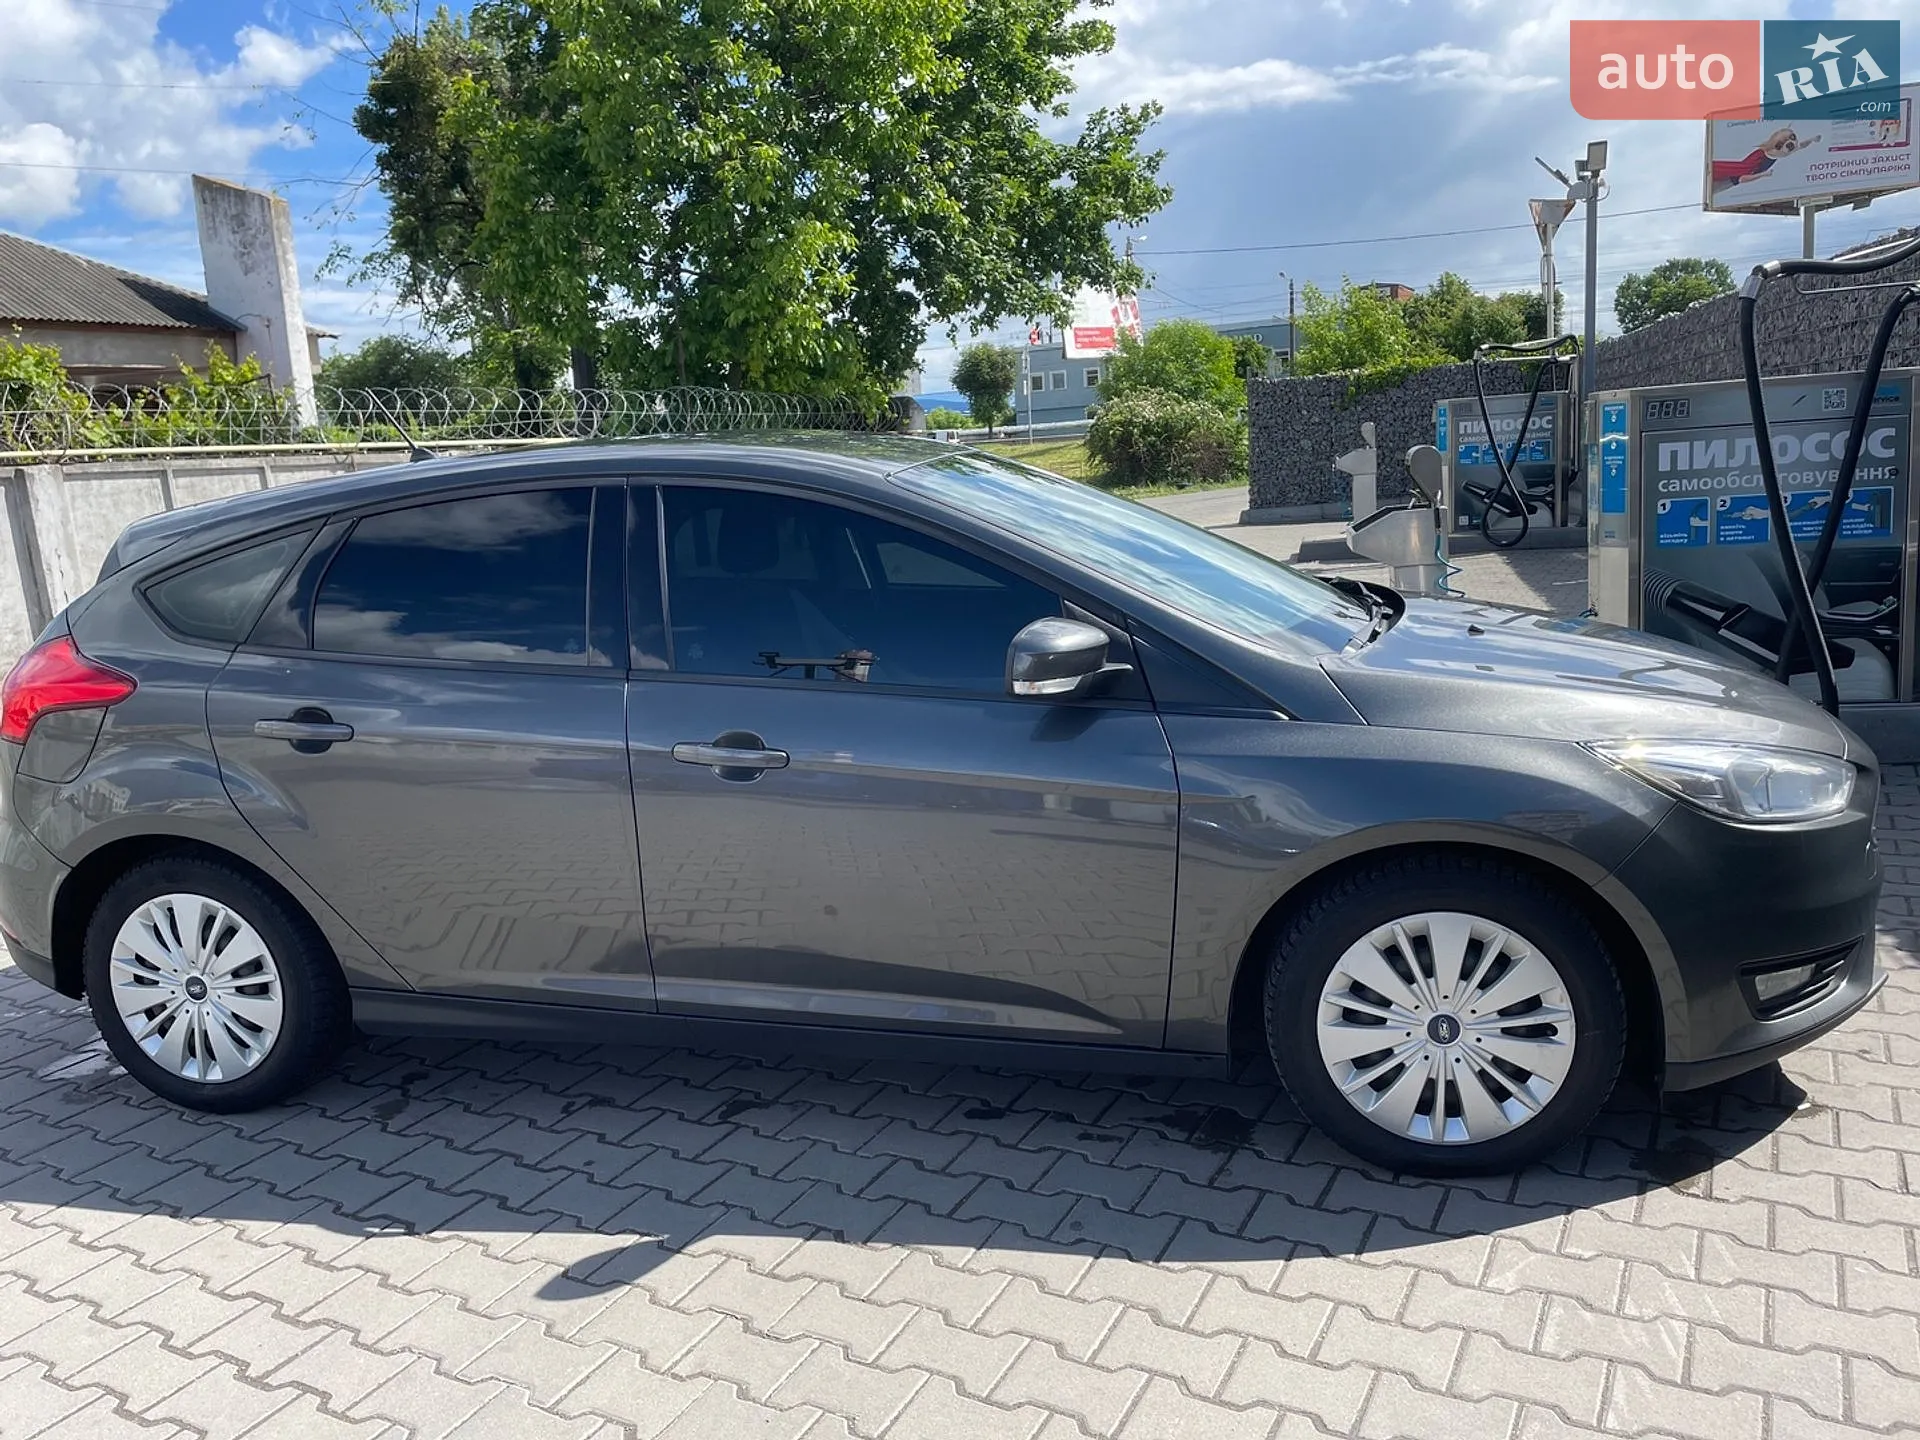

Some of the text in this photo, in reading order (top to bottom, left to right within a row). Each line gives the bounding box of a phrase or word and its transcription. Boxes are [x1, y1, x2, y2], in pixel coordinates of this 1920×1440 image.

[1870, 153, 1912, 166] ЗАХИСТ
[1805, 169, 1838, 182] ТВОГО
[1660, 502, 1667, 511] 1
[1719, 498, 1728, 508] 2
